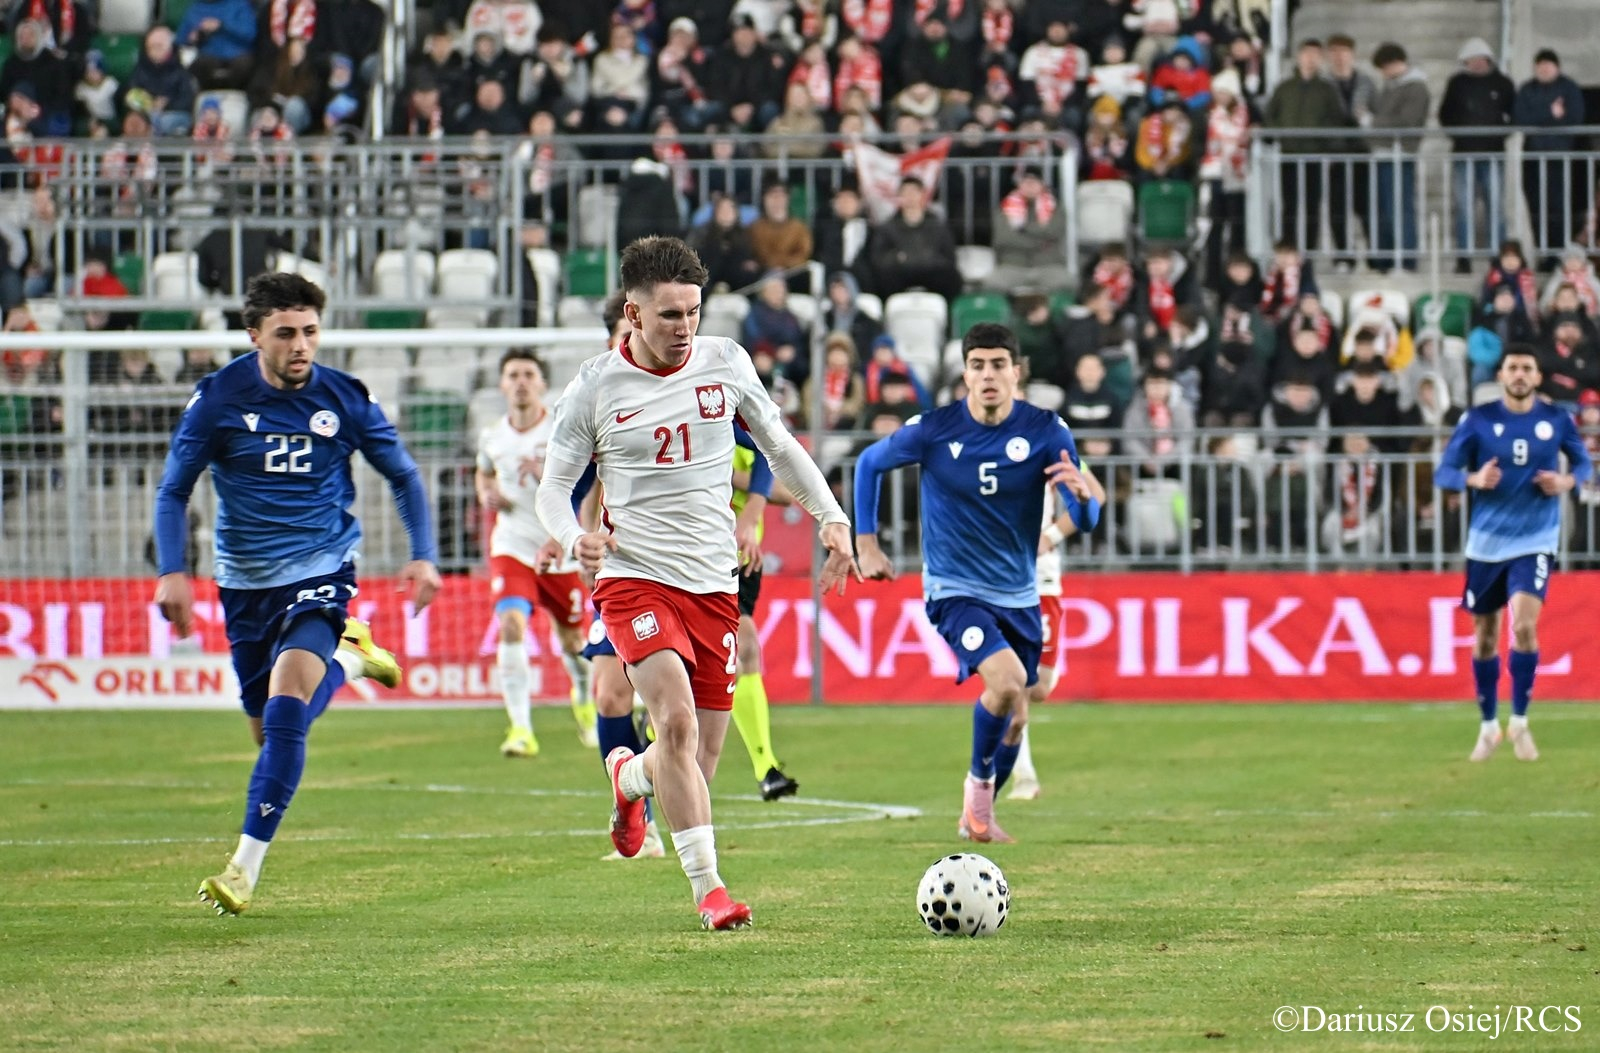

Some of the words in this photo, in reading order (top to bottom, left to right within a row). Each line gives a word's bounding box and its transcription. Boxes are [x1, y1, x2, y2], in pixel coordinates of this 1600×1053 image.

[264, 434, 313, 473] 22
[653, 422, 692, 465] 21
[1512, 438, 1529, 466] 9
[978, 461, 998, 495] 5
[94, 668, 223, 694] ORLEN
